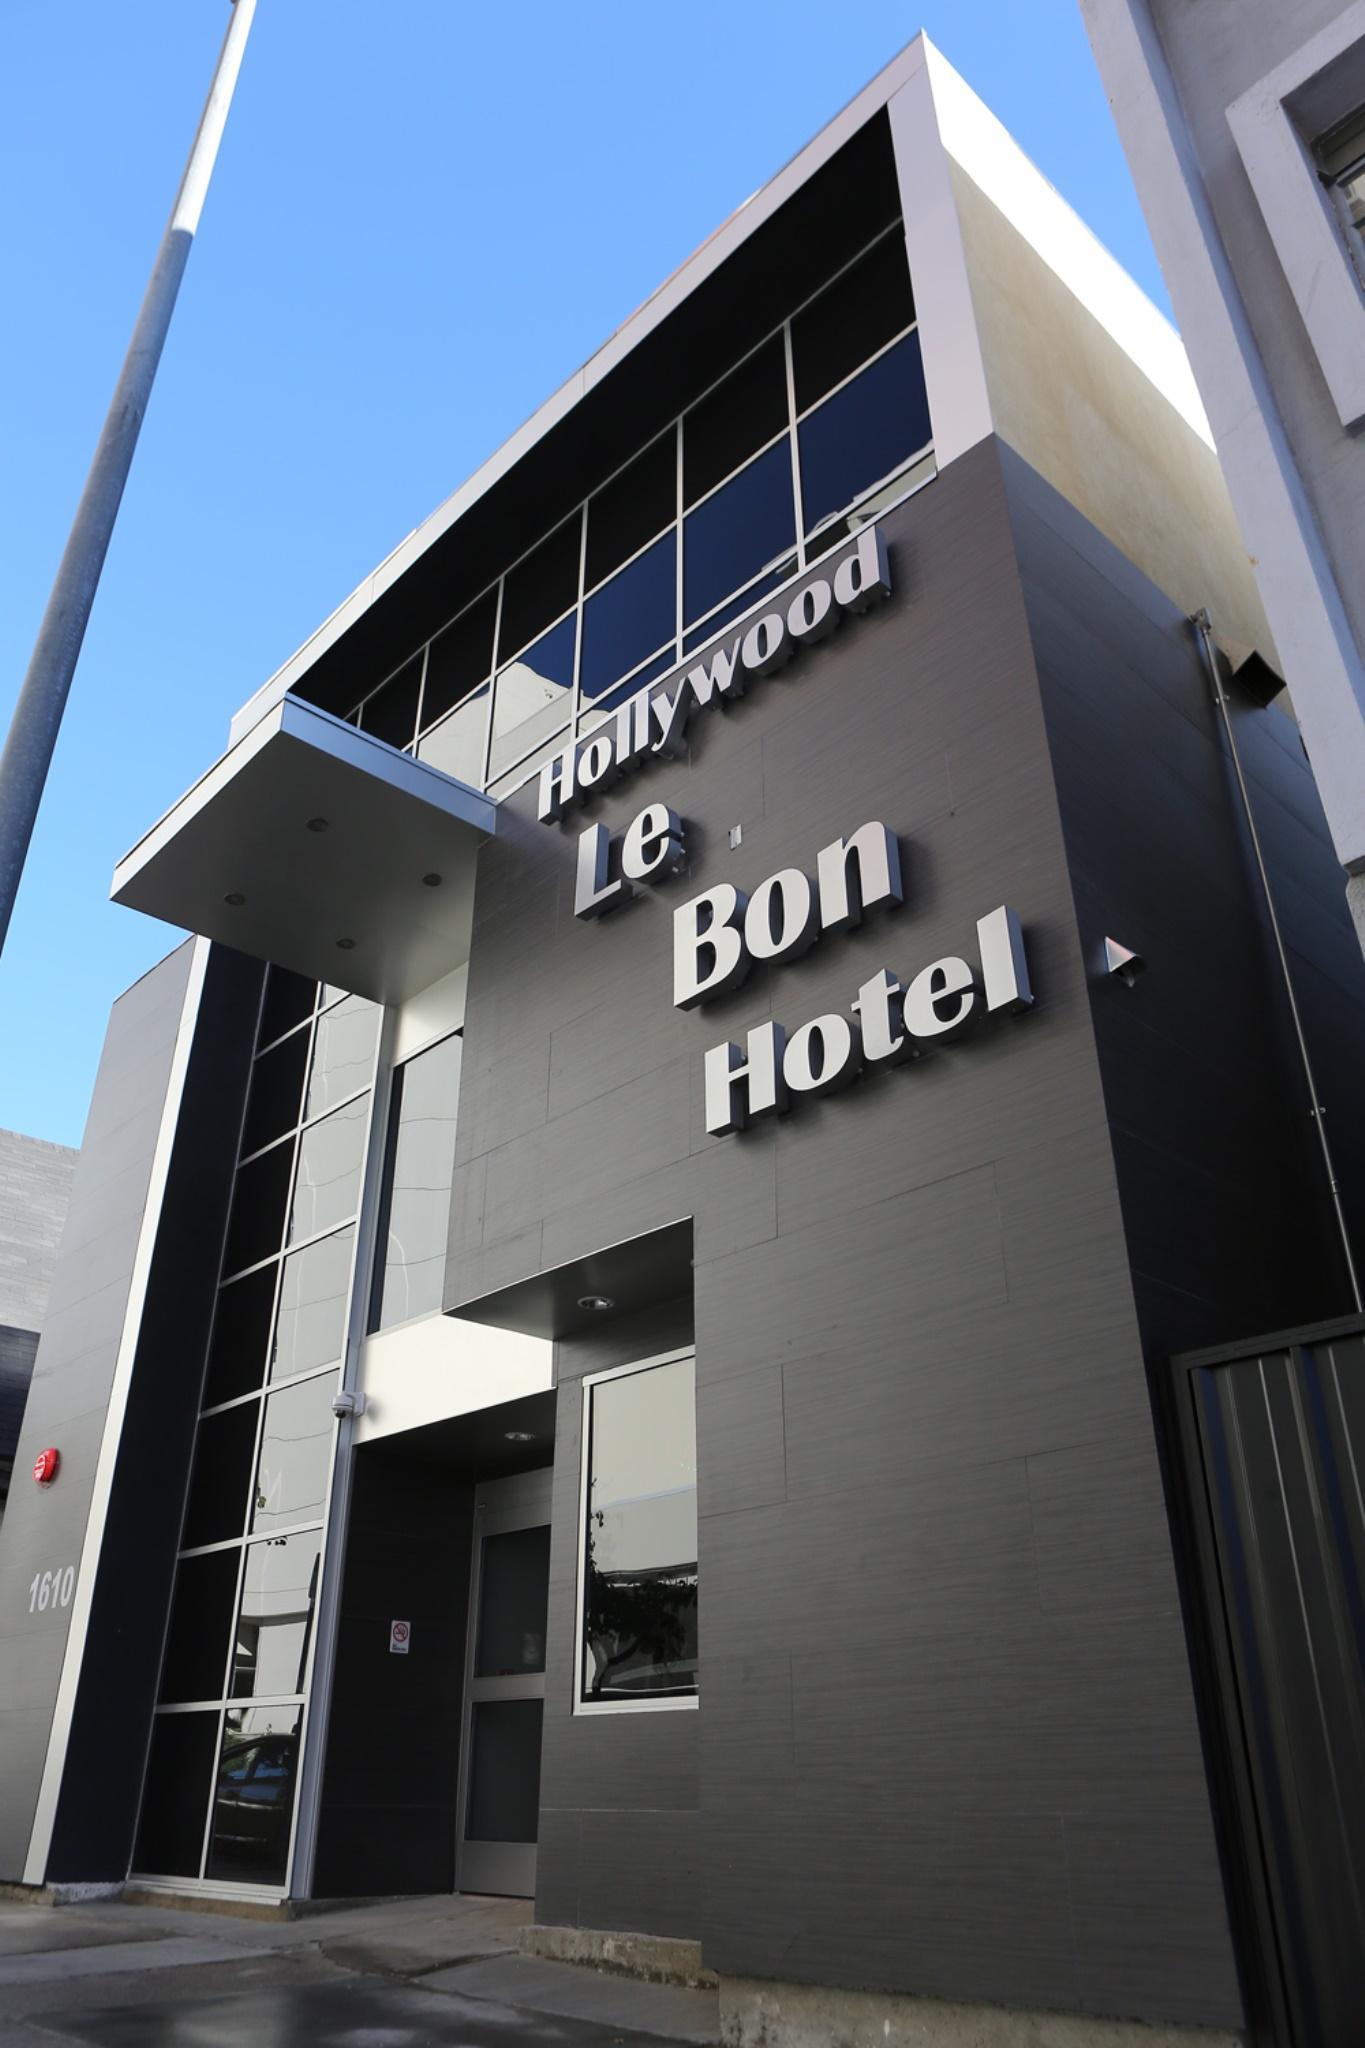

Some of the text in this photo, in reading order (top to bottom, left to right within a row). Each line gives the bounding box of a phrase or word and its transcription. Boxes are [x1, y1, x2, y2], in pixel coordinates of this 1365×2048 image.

[538, 525, 885, 821] Hollywood
[574, 803, 677, 919] Le
[673, 821, 897, 1008] Bon
[705, 904, 1023, 1135] Hotel
[29, 1566, 75, 1613] 1610
